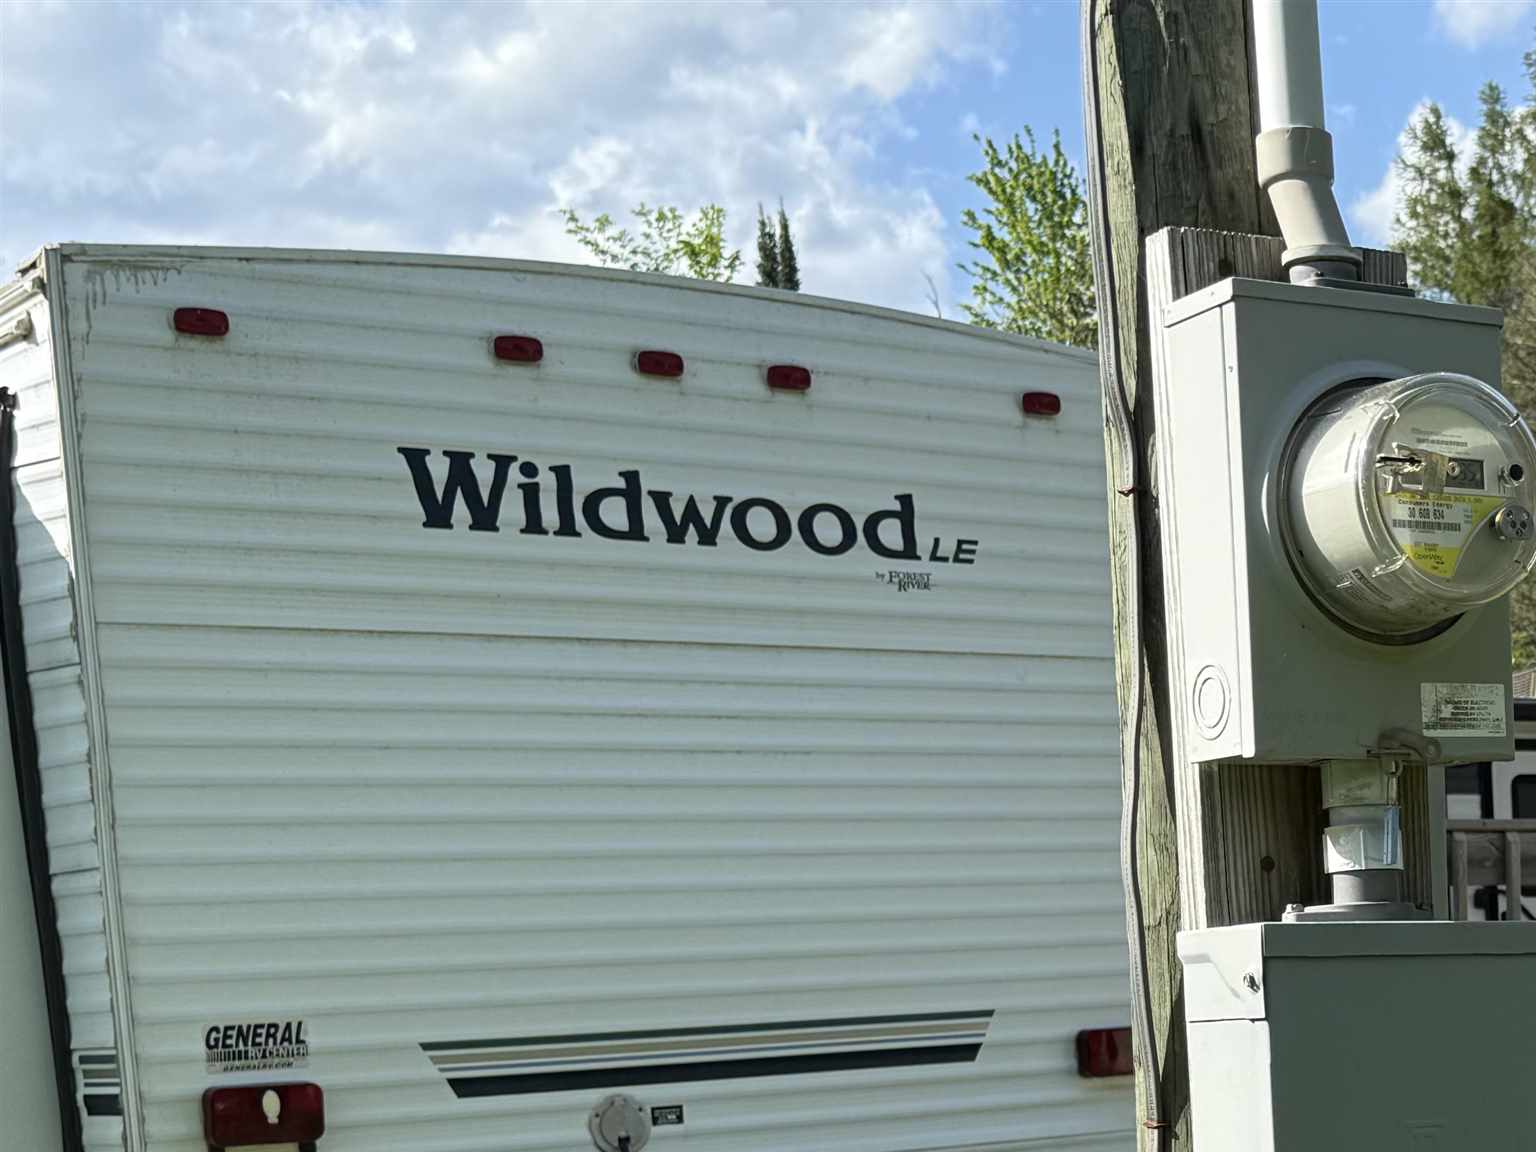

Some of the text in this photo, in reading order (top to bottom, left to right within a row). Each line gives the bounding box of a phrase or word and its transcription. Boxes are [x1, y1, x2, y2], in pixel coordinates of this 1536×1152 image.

[397, 446, 979, 564] Wildwood LE
[1432, 501, 1454, 509] Energy
[887, 570, 932, 584] FOREST
[897, 579, 932, 592] RIVER
[205, 1021, 306, 1050] GENERAL
[249, 1043, 307, 1060] RV CENTER
